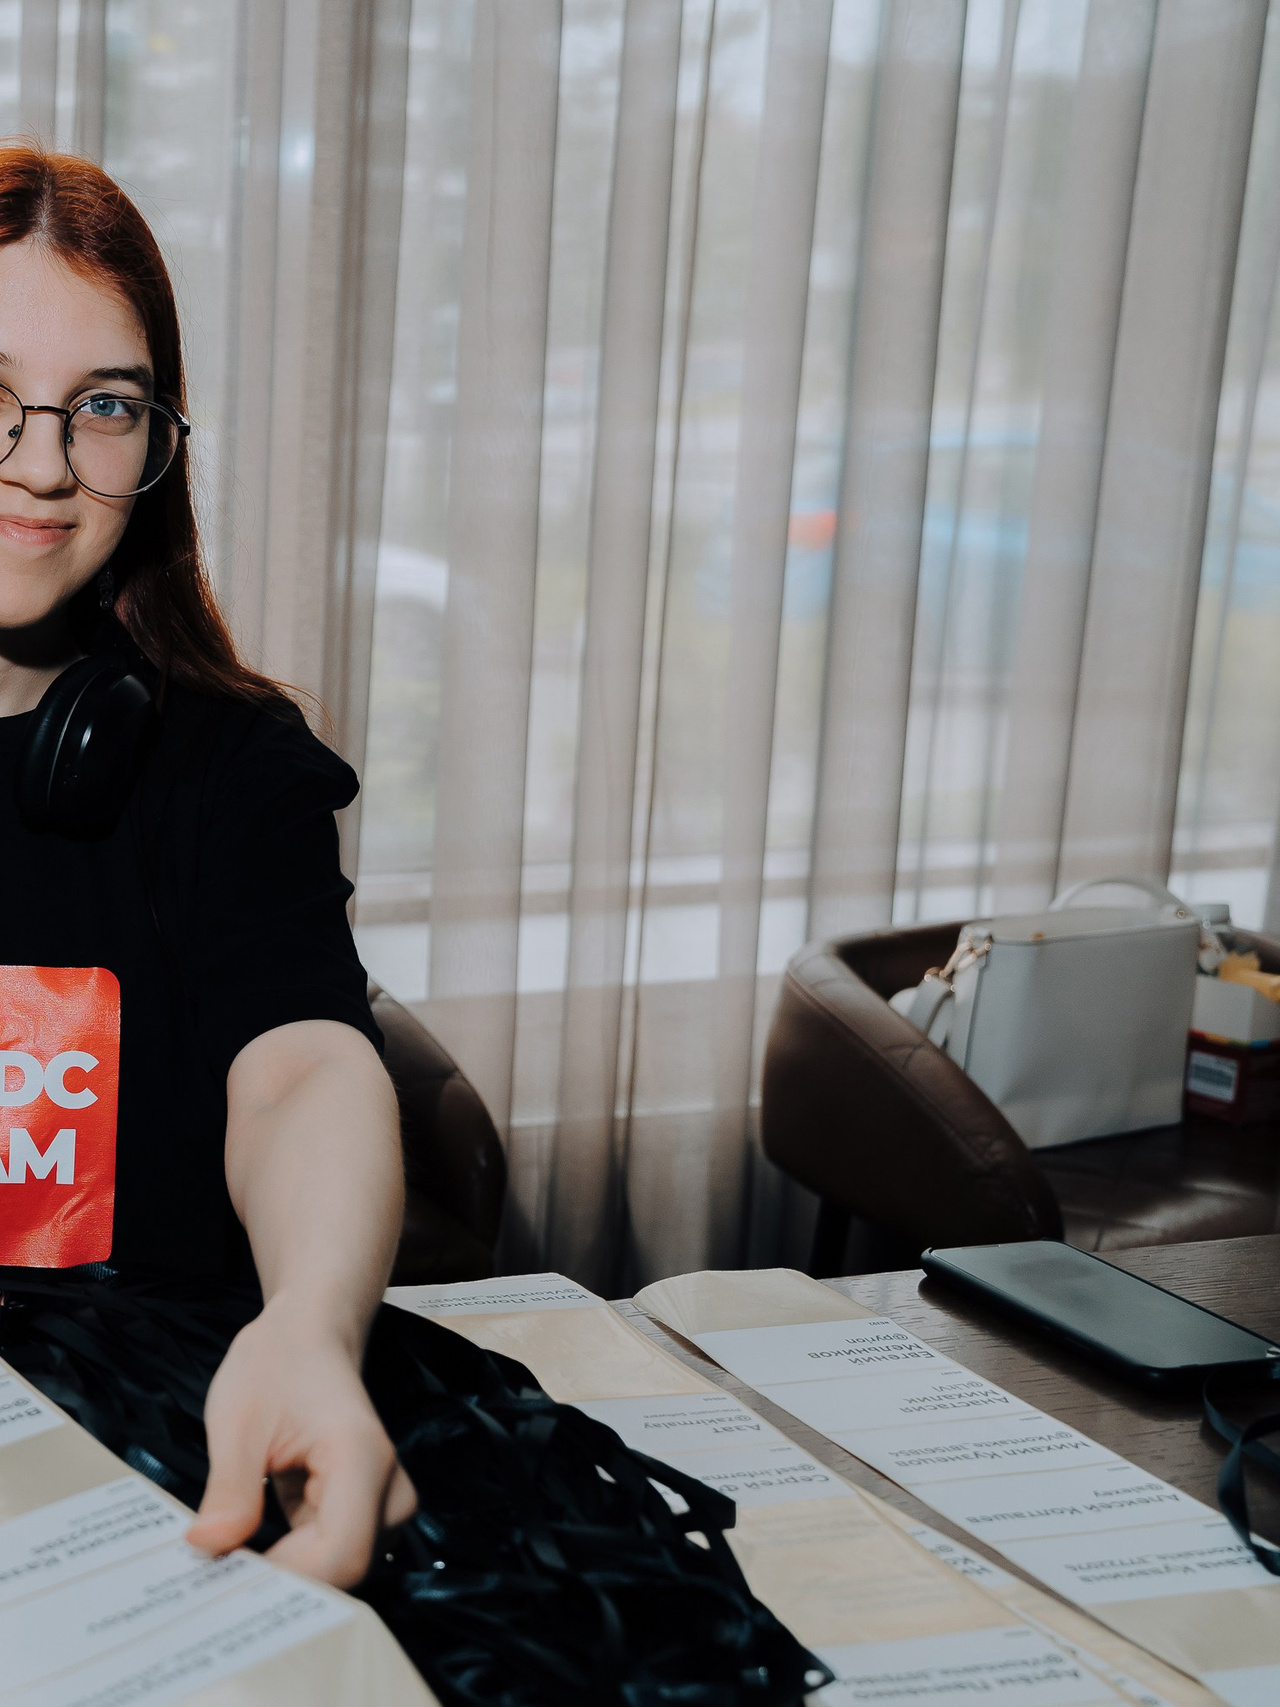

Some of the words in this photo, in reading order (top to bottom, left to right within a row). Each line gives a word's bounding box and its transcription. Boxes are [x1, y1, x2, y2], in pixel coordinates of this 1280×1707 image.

[530, 1294, 589, 1304] Юлия
[807, 1342, 921, 1360] Мельников
[847, 1350, 935, 1367] Евгений
[897, 1397, 1010, 1415] Анастасия
[902, 1388, 1003, 1406] Михалик
[711, 1423, 761, 1435] Азат
[894, 1449, 1002, 1469] Кузнецов
[1004, 1439, 1091, 1461] Михаил
[743, 1474, 830, 1491] Сергей
[1082, 1494, 1182, 1515] Алексей
